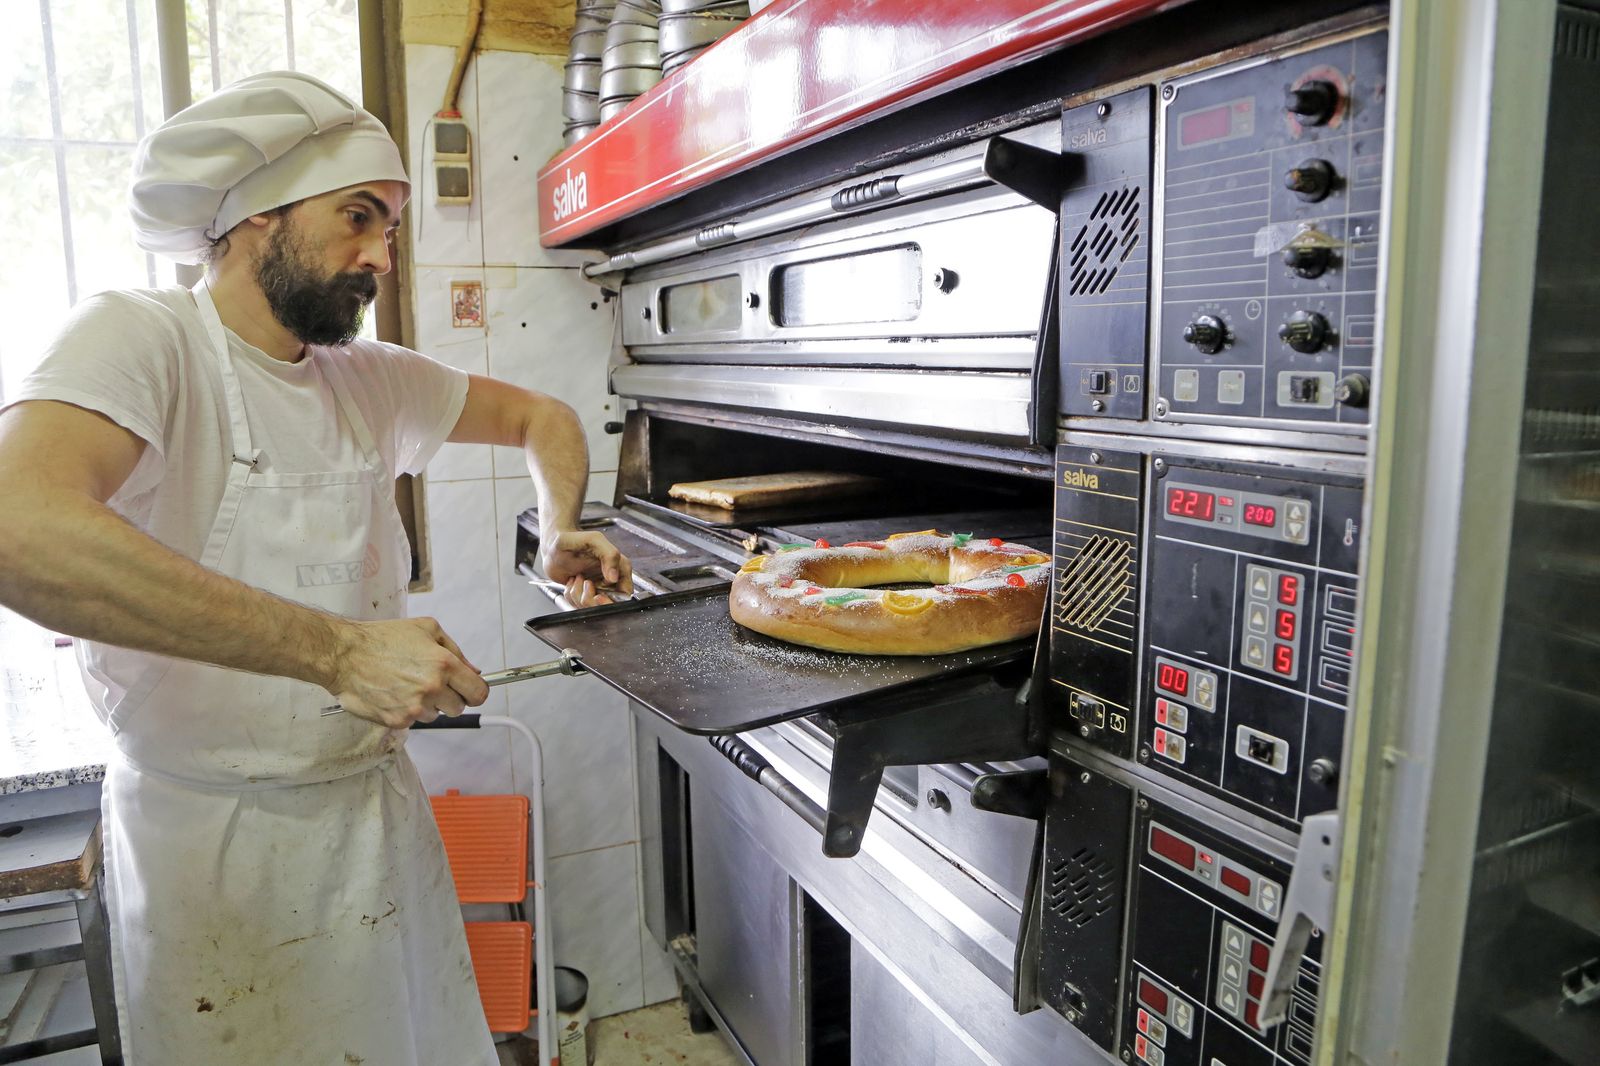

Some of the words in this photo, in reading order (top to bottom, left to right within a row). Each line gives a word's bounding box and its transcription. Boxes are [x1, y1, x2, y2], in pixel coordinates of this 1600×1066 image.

[1070, 126, 1108, 149] salva
[552, 168, 588, 221] salva
[1063, 468, 1099, 490] salva
[1170, 490, 1213, 518] 221
[1245, 506, 1275, 523] 200
[1282, 577, 1297, 602] 5
[1279, 611, 1294, 637] 5
[1277, 647, 1291, 672] 5
[1161, 665, 1187, 692] 00
